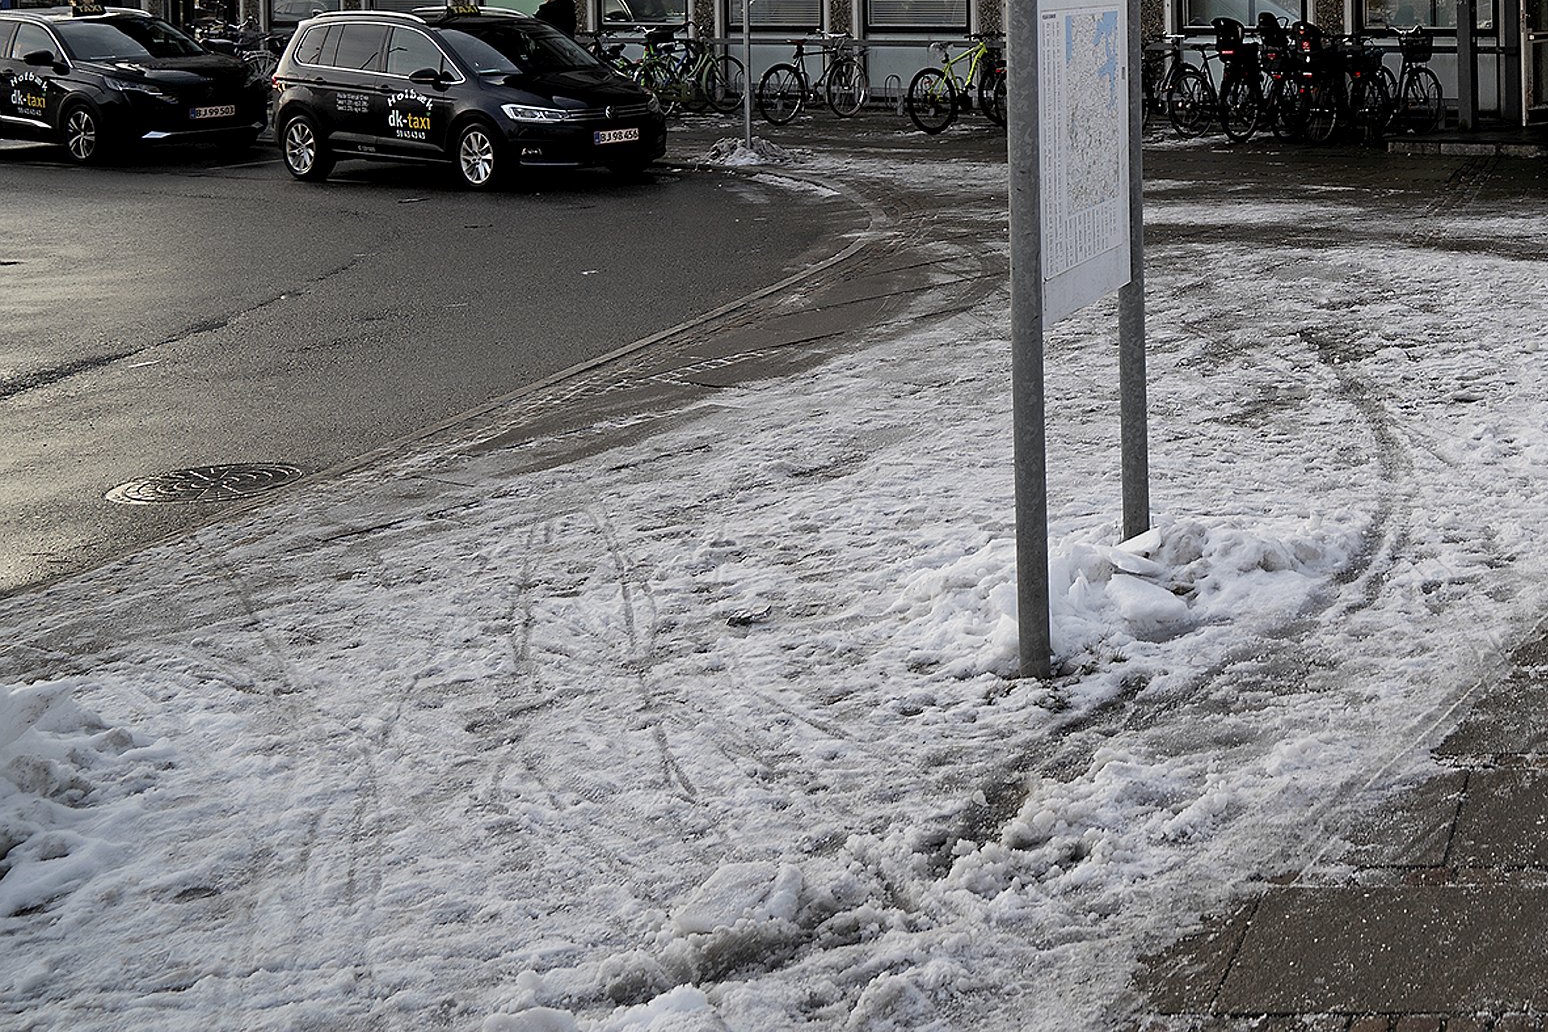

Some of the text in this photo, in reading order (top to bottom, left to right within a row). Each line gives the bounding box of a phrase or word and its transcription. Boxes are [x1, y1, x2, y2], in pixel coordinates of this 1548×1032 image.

[78, 4, 103, 13] TAXI
[452, 5, 479, 14] TAXI
[11, 89, 46, 108] dk-taxi
[388, 109, 431, 130] dk-taxi
